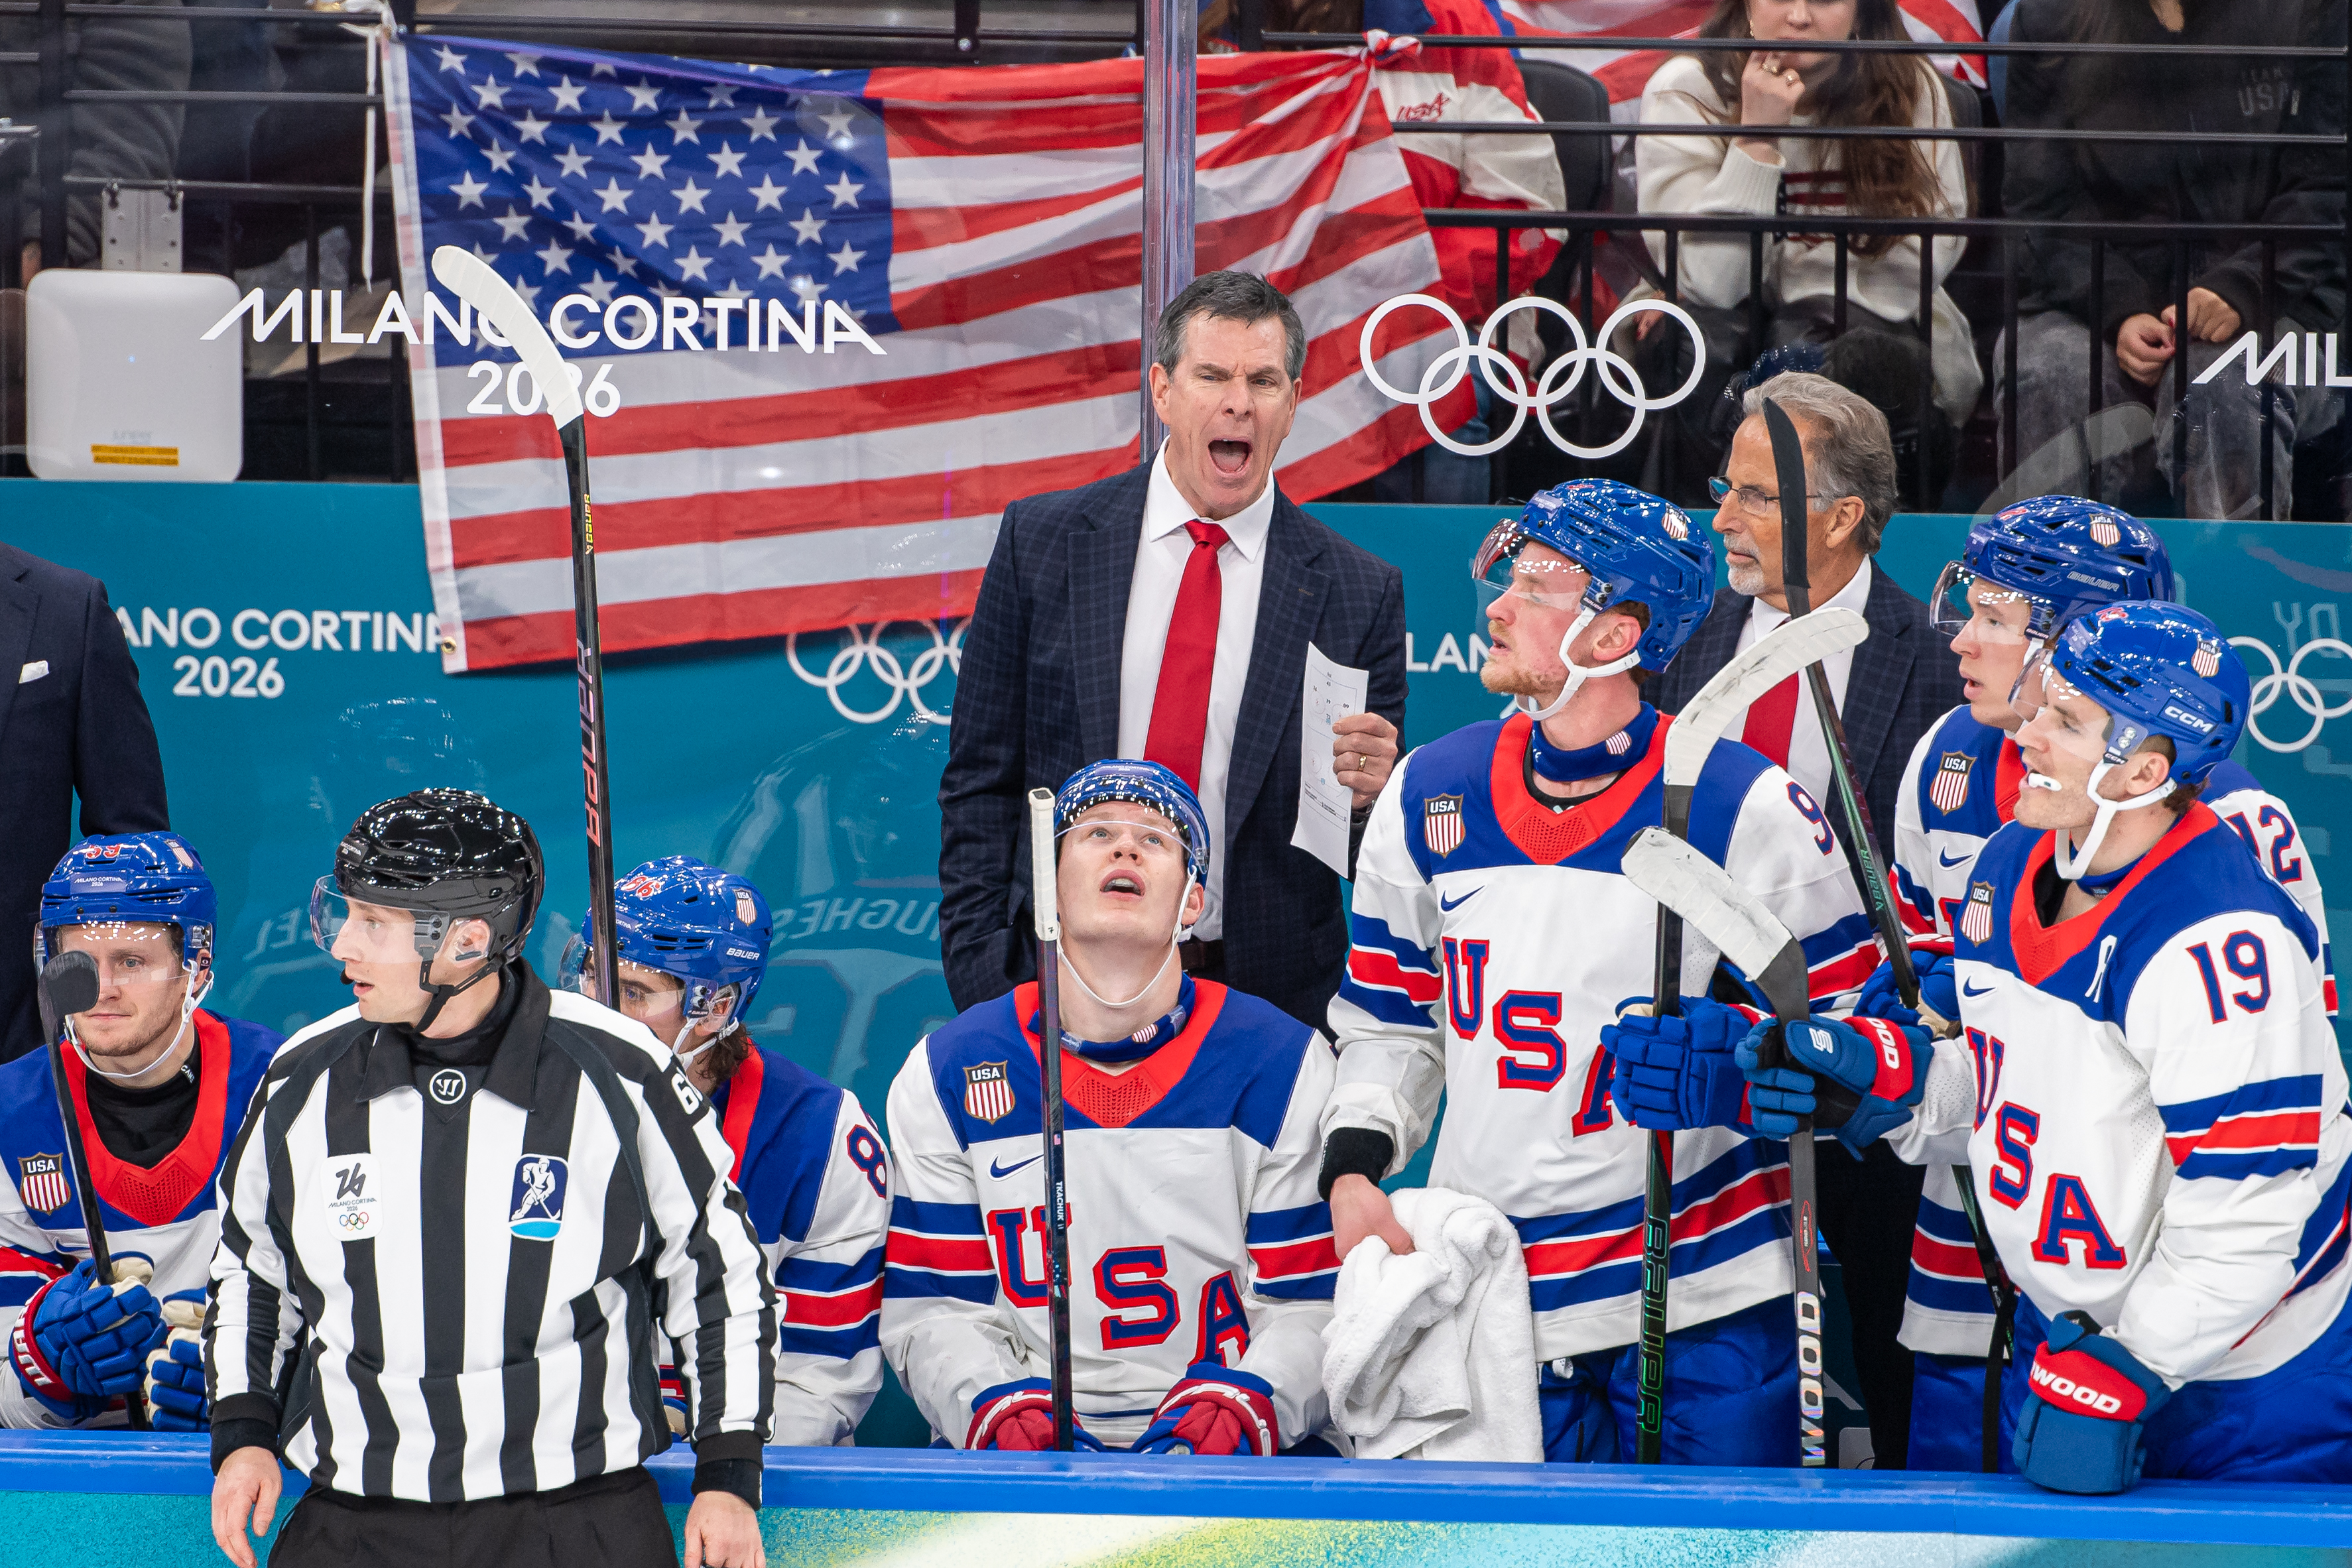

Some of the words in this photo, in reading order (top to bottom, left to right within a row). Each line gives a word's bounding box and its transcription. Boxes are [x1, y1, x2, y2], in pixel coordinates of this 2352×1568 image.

[550, 294, 888, 355] CORTINA
[2191, 331, 2352, 387] MIL
[467, 360, 621, 418] 206
[2067, 571, 2120, 592] BAUER
[172, 654, 286, 699] 2026
[576, 638, 601, 847] BAUER
[2164, 705, 2213, 733] CCM
[1944, 756, 1966, 772] USA
[1430, 800, 1455, 813] USA
[1786, 781, 1834, 856] 9
[2224, 804, 2302, 884] 12
[1973, 887, 1989, 902] USA
[616, 919, 632, 930] ORTINA
[726, 947, 760, 961] BAUER
[2084, 934, 2117, 1003] A
[2185, 930, 2271, 1024] 19
[671, 1066, 704, 1115] 6
[971, 1067, 1001, 1082] USA
[27, 1158, 56, 1174] USA
[846, 1123, 887, 1200] 8
[1965, 1026, 2127, 1270] USA
[328, 1200, 351, 1209] MILANO
[1056, 1181, 1064, 1221] TKACHUK
[986, 1202, 1251, 1368] USA
[1636, 1215, 1668, 1433] BAUER
